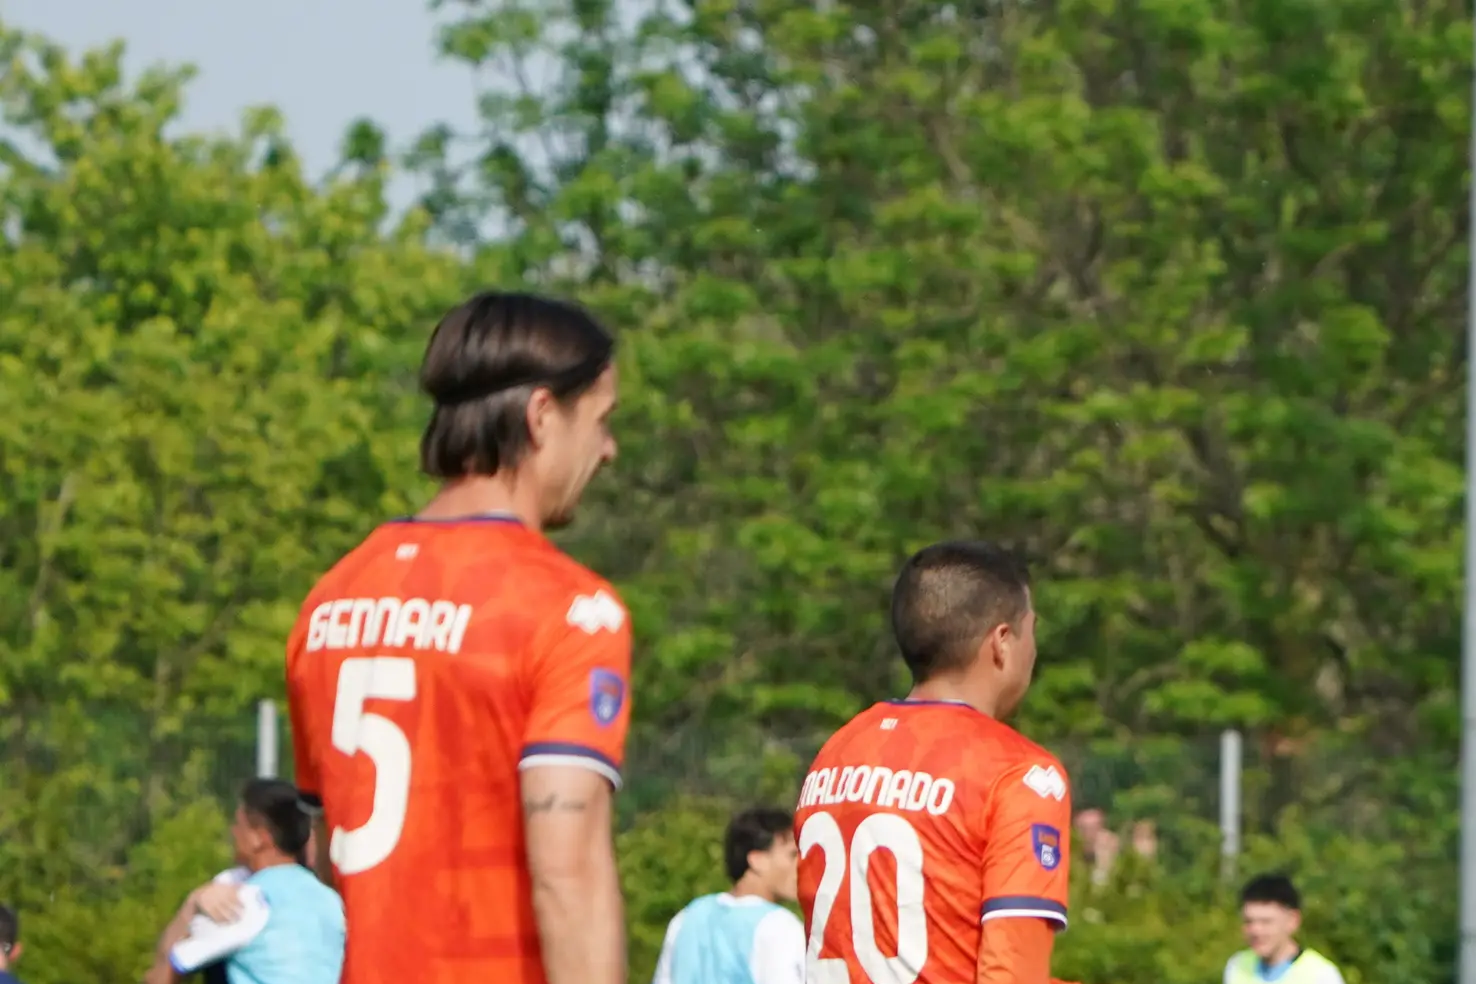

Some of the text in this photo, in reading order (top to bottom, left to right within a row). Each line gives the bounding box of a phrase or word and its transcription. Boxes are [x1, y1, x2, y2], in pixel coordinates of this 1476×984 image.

[306, 597, 473, 654] GENNARI
[330, 657, 417, 876] 5
[796, 764, 956, 816] MALDONADO
